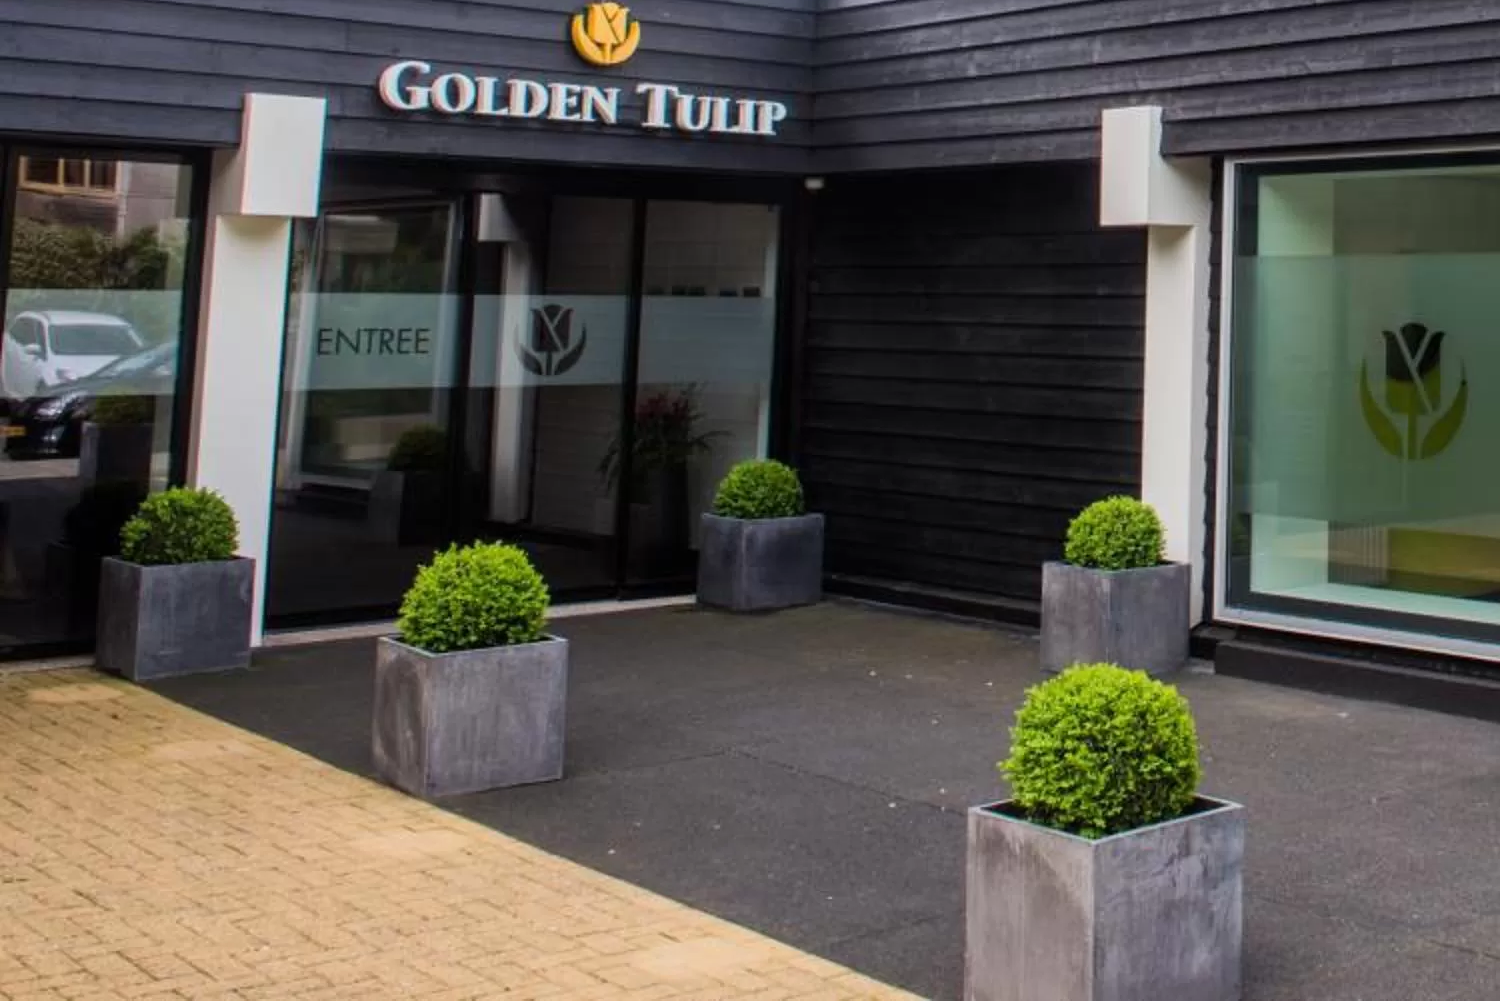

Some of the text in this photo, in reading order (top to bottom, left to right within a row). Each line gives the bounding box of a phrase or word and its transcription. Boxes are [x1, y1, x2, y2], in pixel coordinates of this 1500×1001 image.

[379, 60, 788, 136] GOLDEN TULIP
[316, 327, 432, 356] ENTREE
